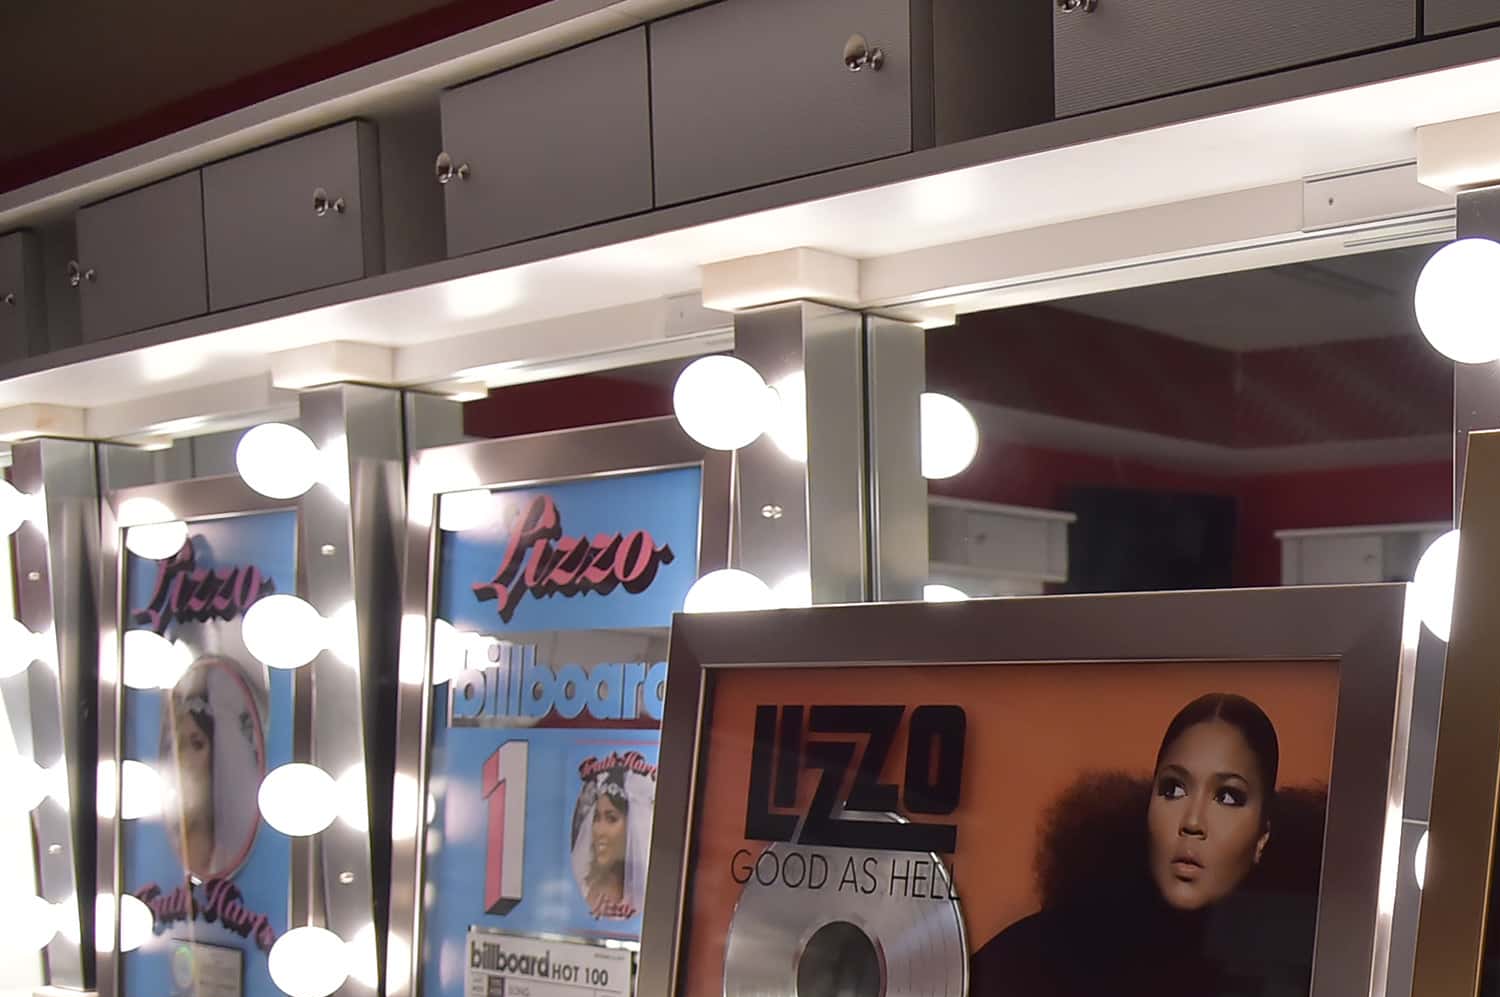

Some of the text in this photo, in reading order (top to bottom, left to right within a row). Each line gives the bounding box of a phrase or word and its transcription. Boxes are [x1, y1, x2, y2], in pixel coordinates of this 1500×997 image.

[471, 494, 676, 624] Lizzo
[744, 704, 966, 853] LIZZO
[730, 849, 960, 901] GOOD AS HELL
[471, 941, 609, 986] billboard HOT 100
